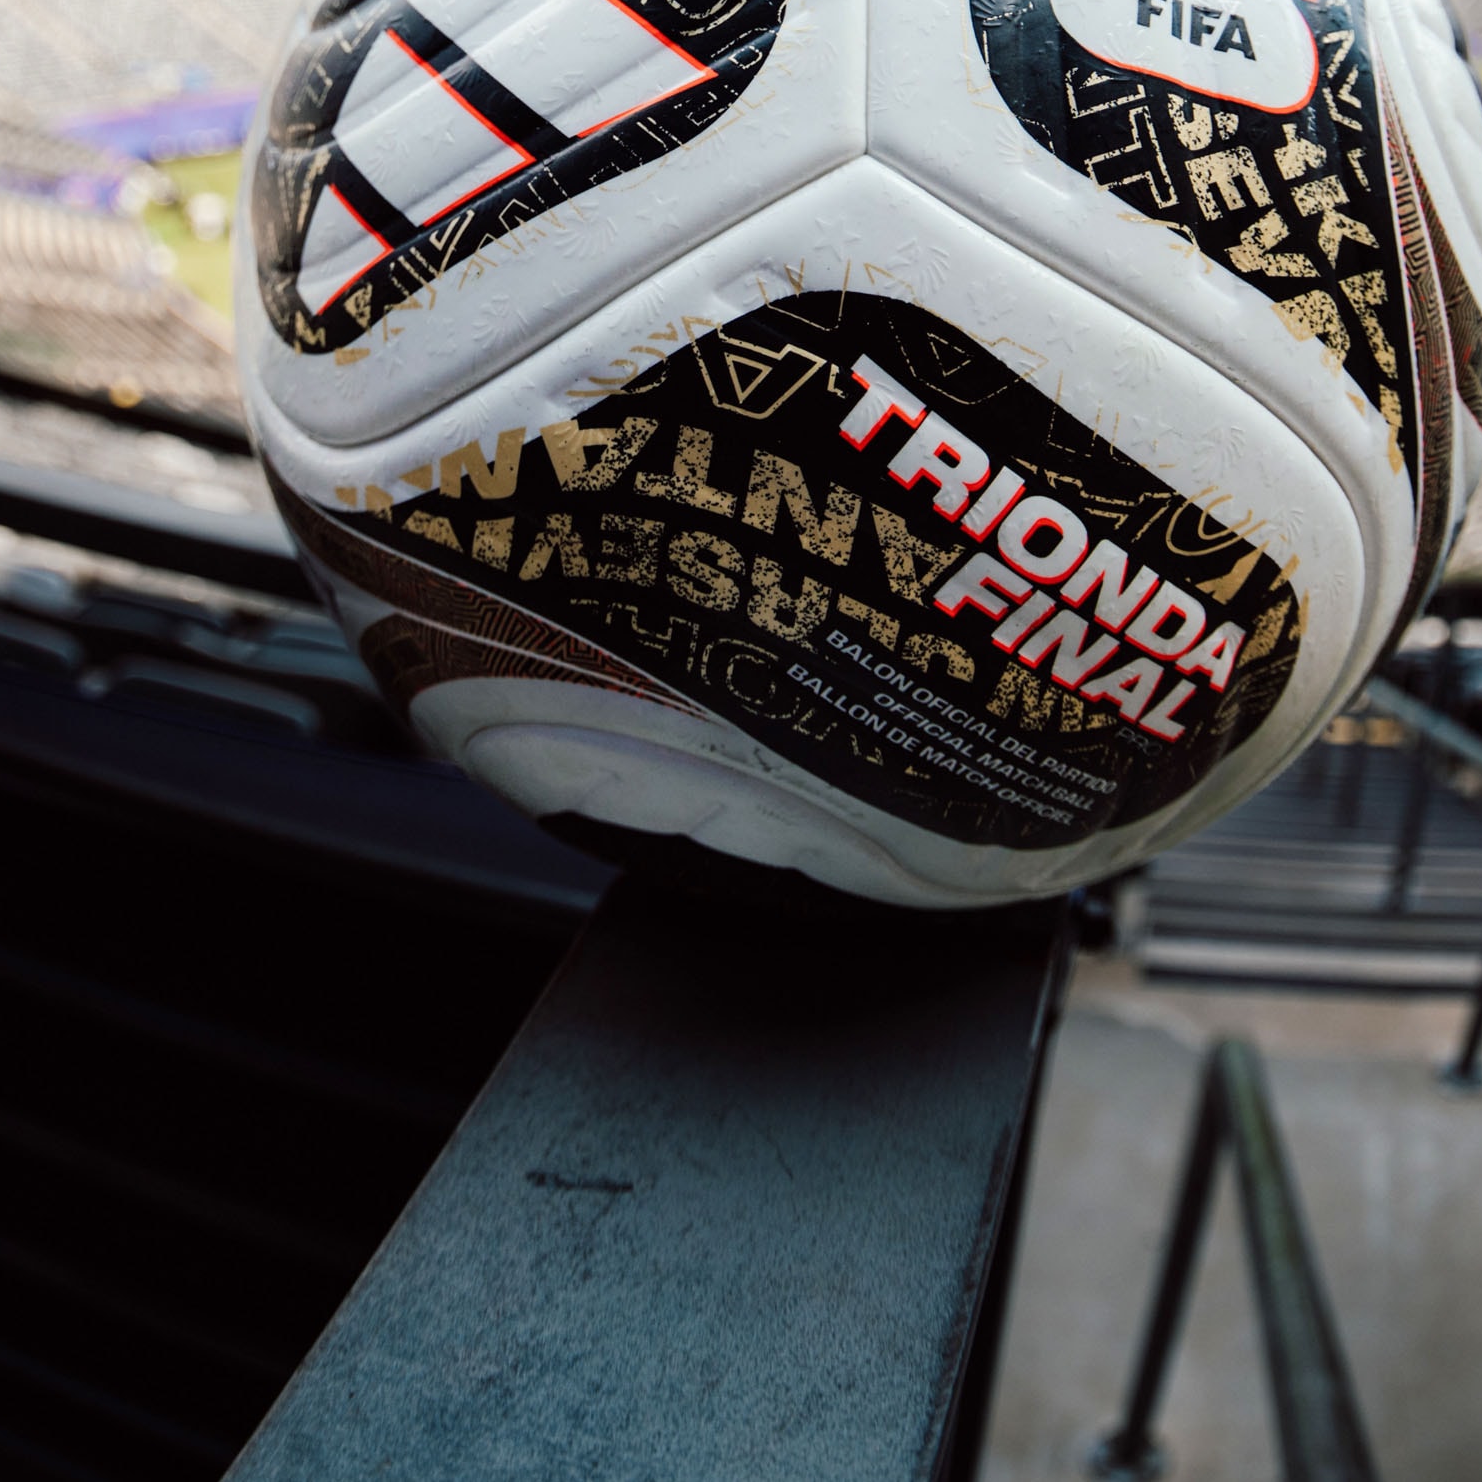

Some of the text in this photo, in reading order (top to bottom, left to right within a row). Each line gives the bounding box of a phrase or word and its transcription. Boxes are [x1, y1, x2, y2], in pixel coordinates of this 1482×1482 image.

[839, 353, 1247, 693] TRIONDA
[826, 629, 914, 693] BALON
[912, 687, 997, 744] OFICIAL
[999, 736, 1037, 765] DEL
[1039, 756, 1118, 795] PARTIDO
[933, 552, 1197, 743] FINAL
[786, 663, 888, 733] BALLON
[886, 726, 922, 752] DE
[919, 745, 1000, 791] MATCH
[874, 693, 974, 758] OFFICIAL
[976, 752, 1054, 795] MATCH
[1050, 785, 1096, 811] BALL
[1115, 725, 1164, 756] PRO
